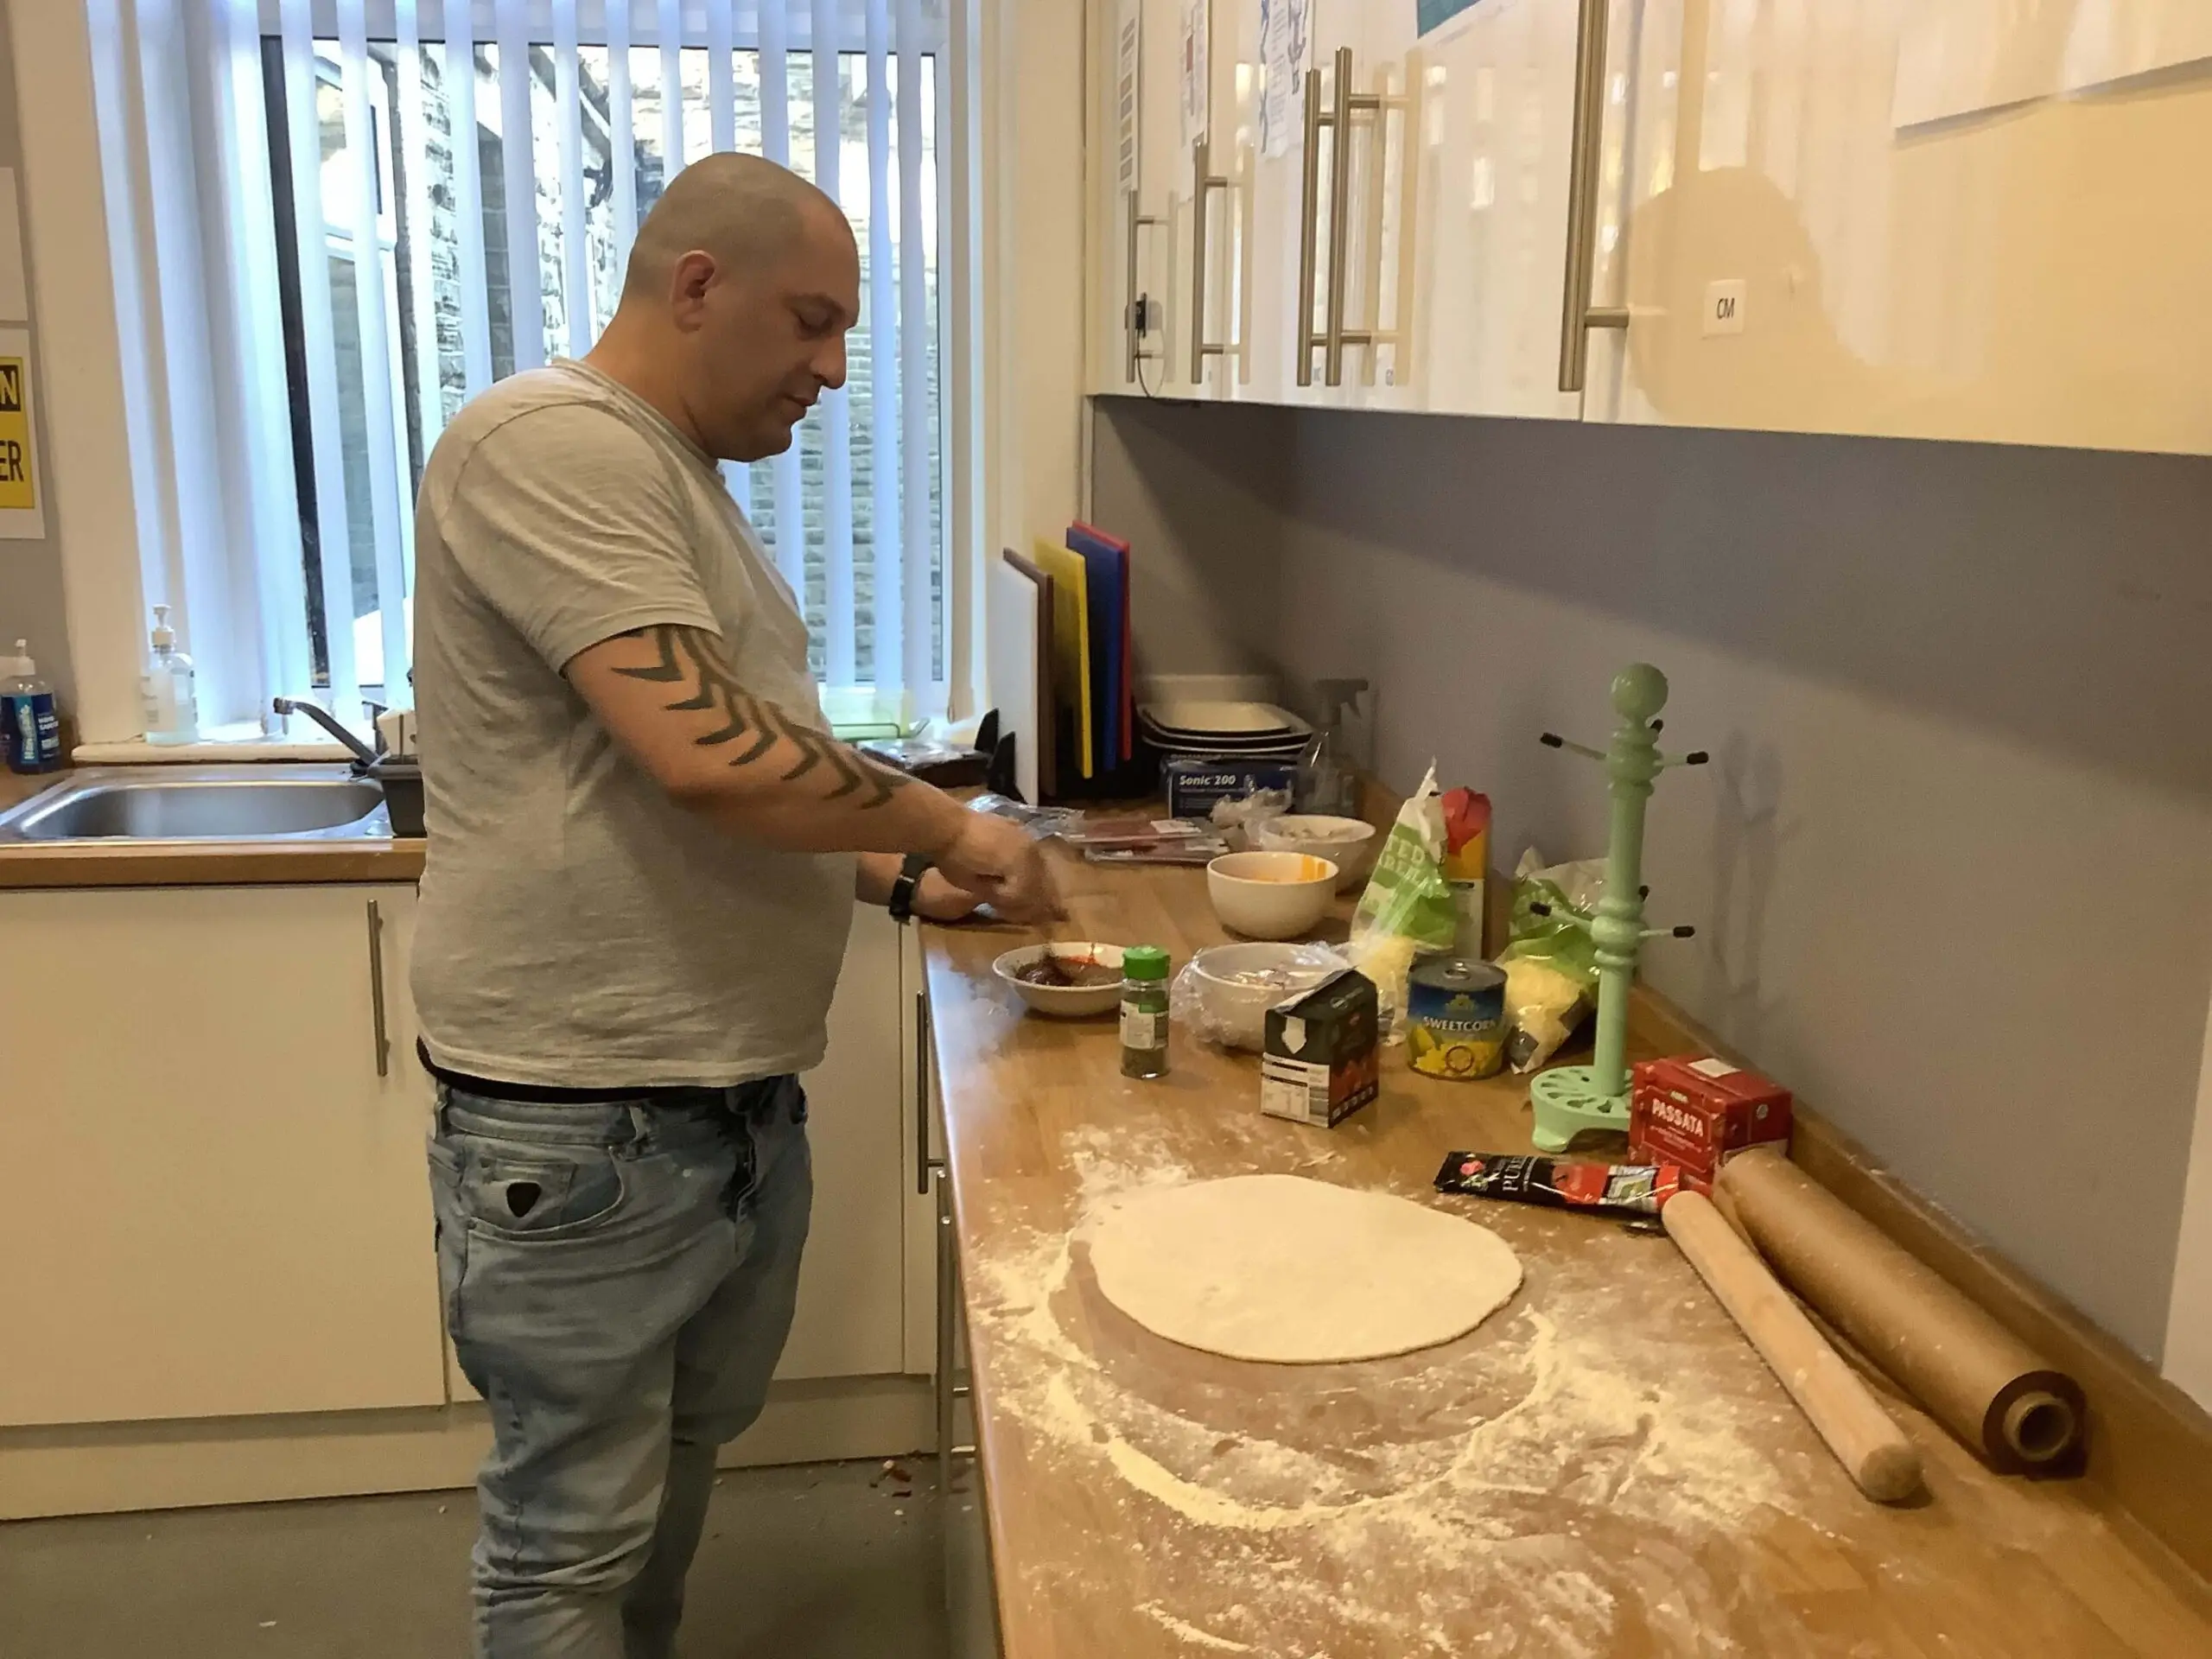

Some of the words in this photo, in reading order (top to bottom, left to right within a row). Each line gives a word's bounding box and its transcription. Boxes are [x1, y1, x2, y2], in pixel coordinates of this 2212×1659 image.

[1717, 297, 1735, 320] CM
[1179, 774, 1211, 785] Sonic
[1214, 774, 1236, 785] 200
[1652, 1097, 1704, 1137] PASSATA
